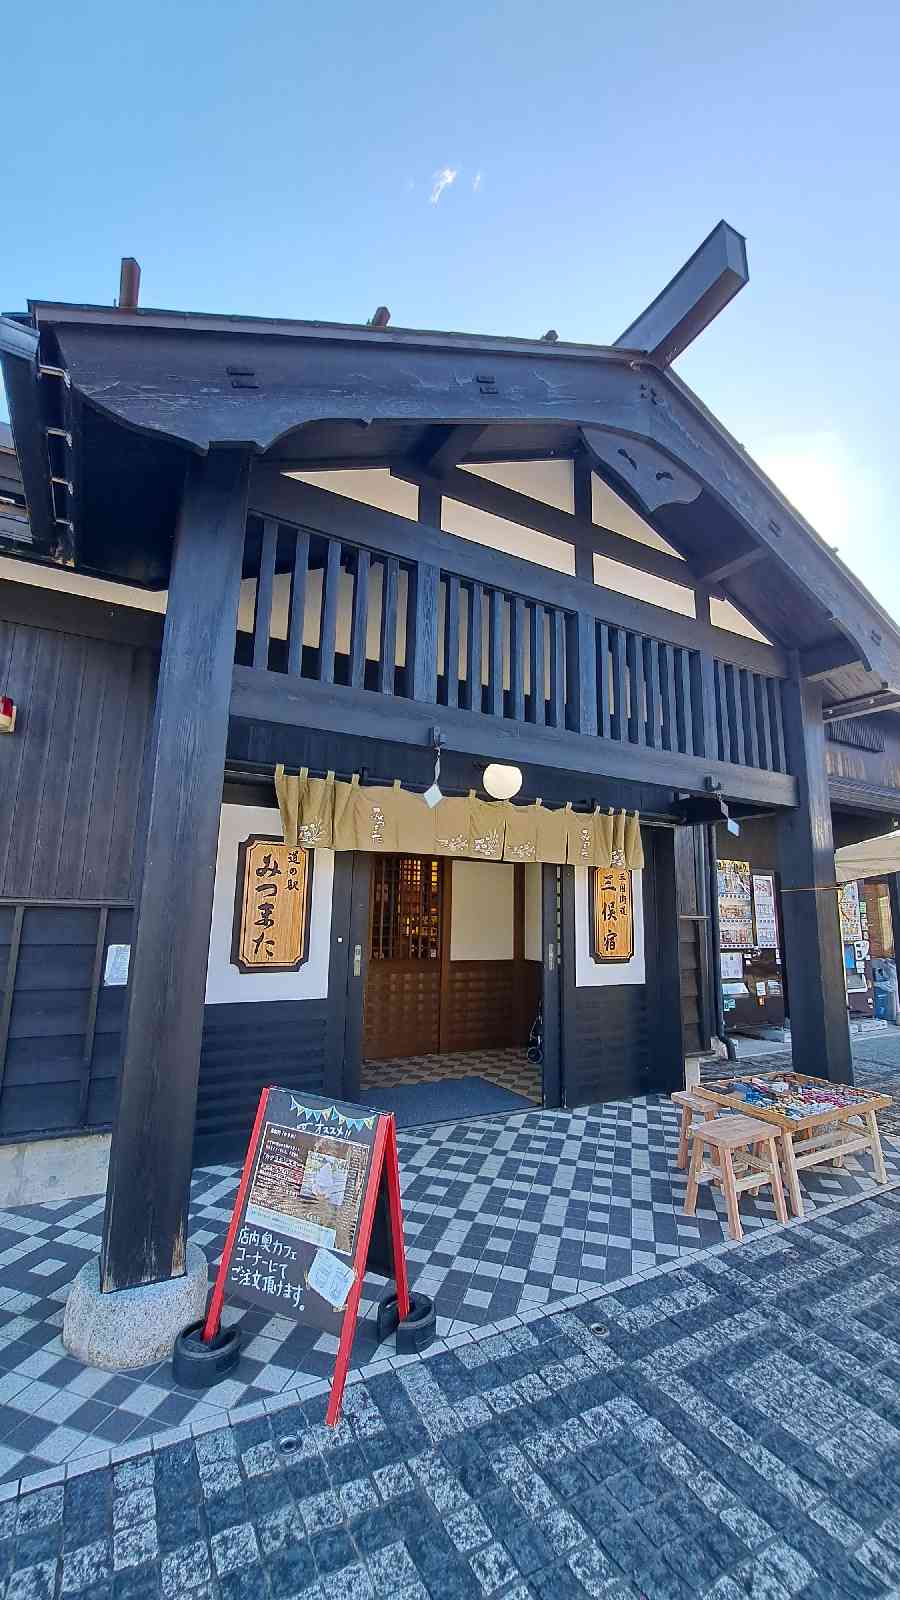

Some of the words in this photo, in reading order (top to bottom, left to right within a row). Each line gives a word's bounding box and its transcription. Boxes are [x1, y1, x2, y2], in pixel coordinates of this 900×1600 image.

[285, 850, 300, 891] 道の駅
[252, 853, 281, 961] みつまた
[235, 1247, 289, 1280] コーナーにて
[238, 1225, 298, 1261] 店内奥カフェ
[231, 1266, 305, 1312] ご注文頂けます。
